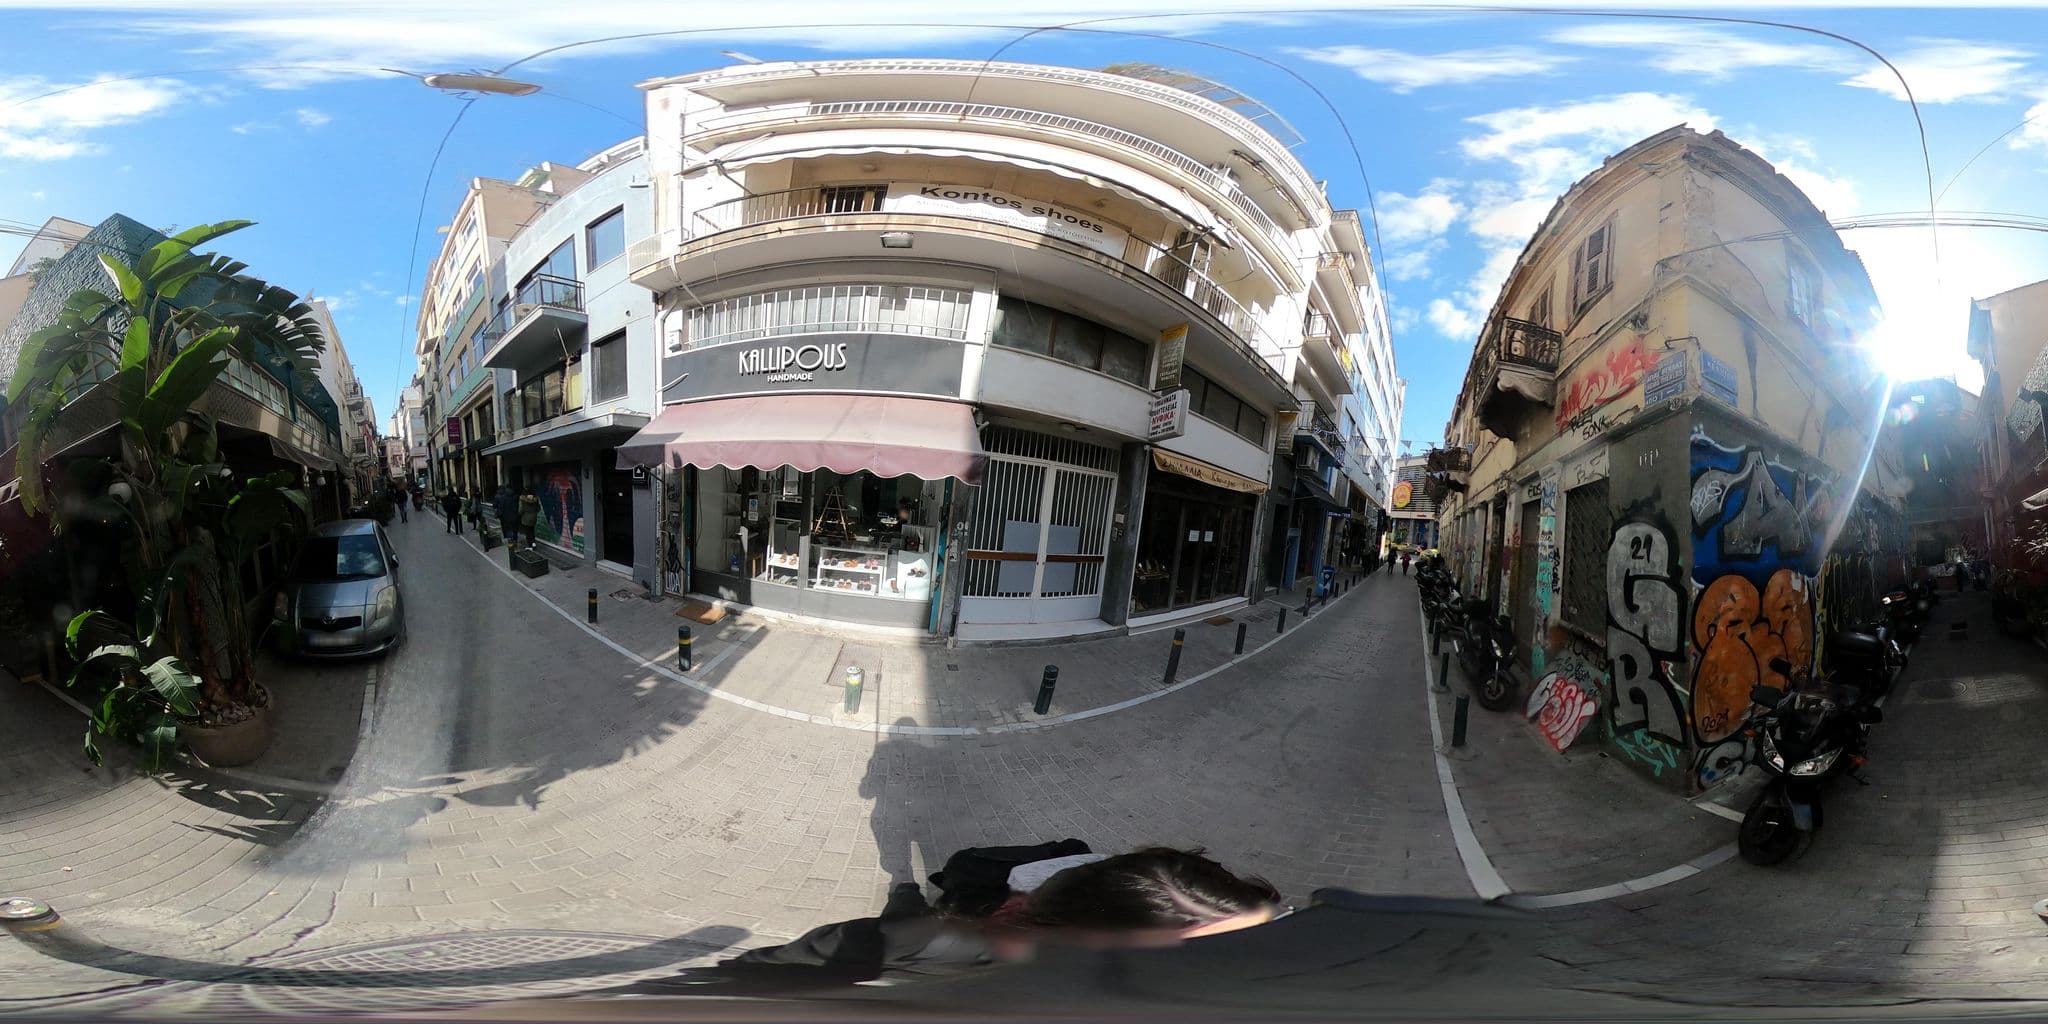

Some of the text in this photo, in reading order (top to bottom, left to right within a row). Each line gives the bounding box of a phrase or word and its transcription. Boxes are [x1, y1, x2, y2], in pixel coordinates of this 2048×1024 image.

[920, 186, 1022, 210] Kontos
[1031, 205, 1104, 234] shoes
[738, 342, 848, 374] KALLIPOUS
[766, 372, 813, 384] HANDMADE
[1630, 533, 1653, 564] 21
